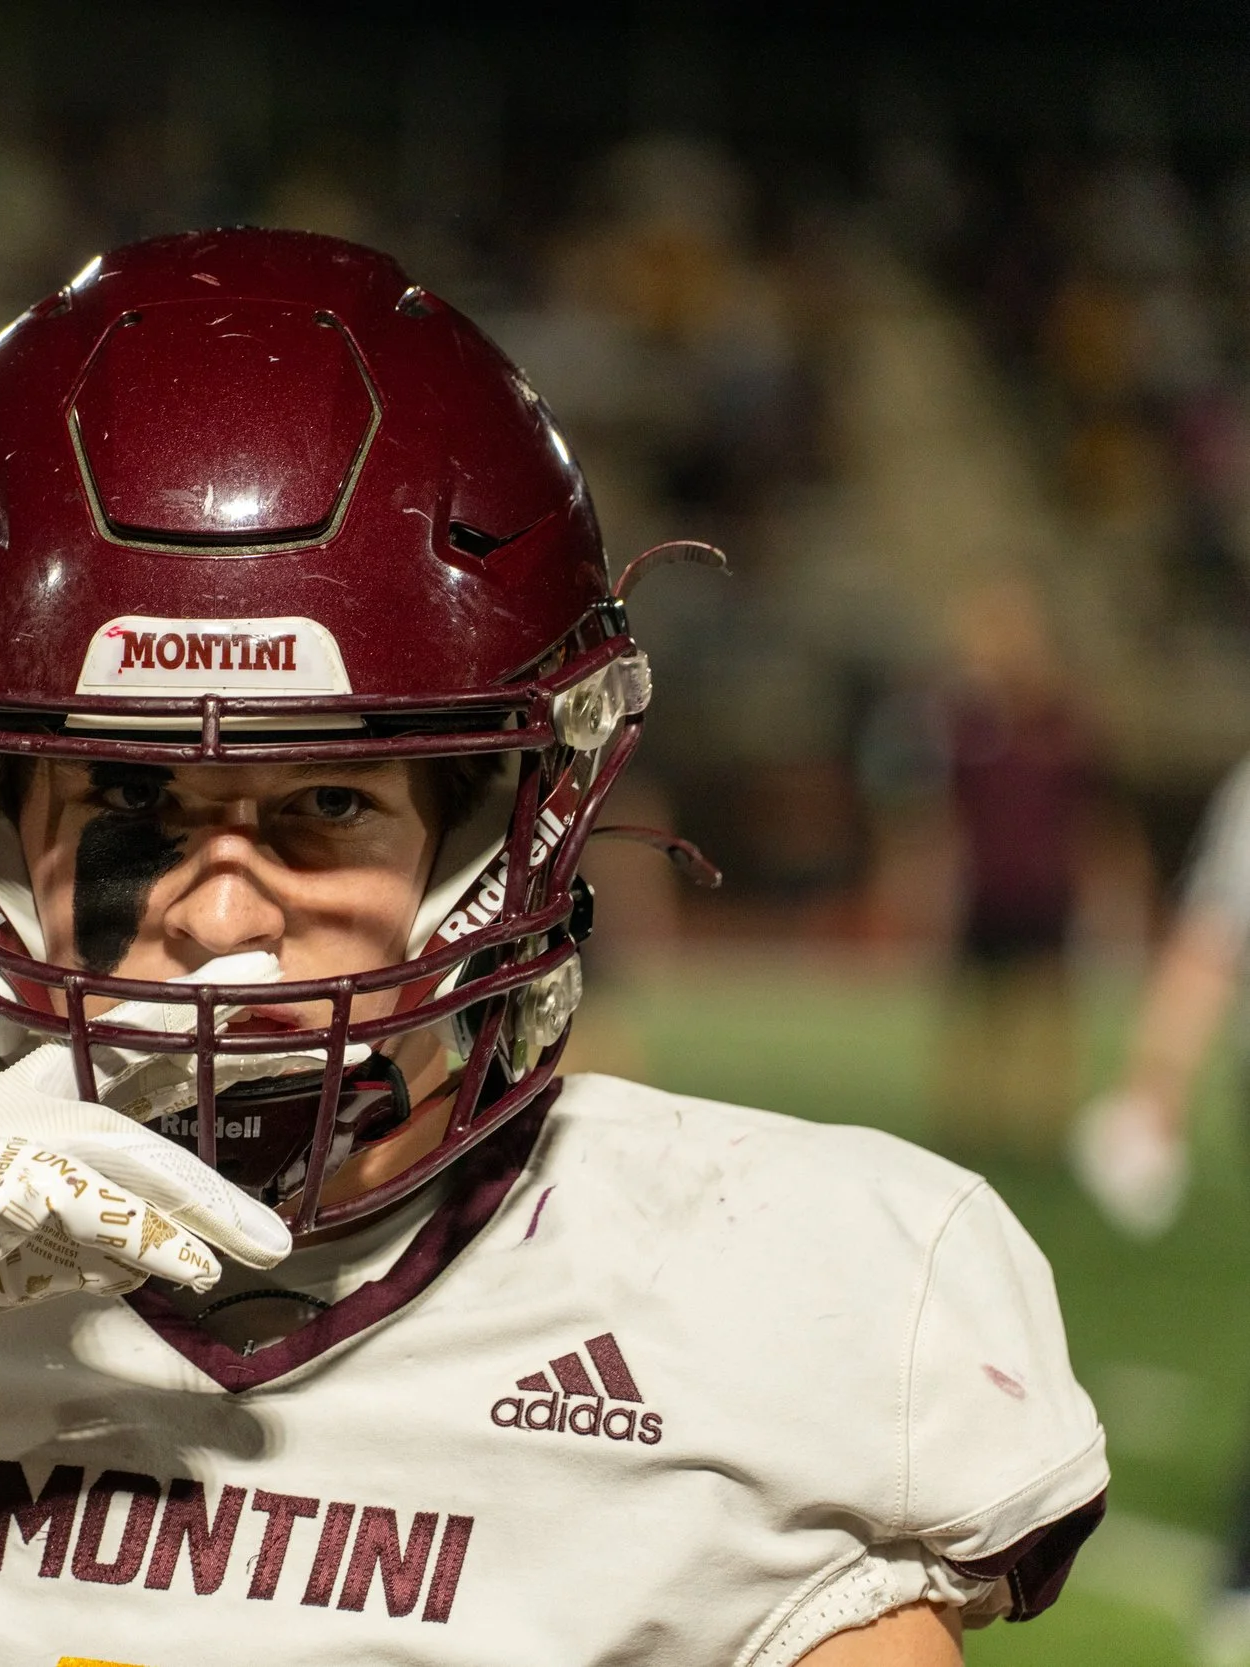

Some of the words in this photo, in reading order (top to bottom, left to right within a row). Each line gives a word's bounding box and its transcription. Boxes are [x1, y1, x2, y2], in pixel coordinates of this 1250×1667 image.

[121, 632, 296, 671] MONTINI
[32, 1151, 88, 1198] DNA
[26, 1241, 53, 1261] PLAYER
[53, 1255, 75, 1268] EVER
[43, 1238, 78, 1259] GREATEST
[178, 1247, 211, 1273] DNA
[491, 1391, 663, 1446] adidas
